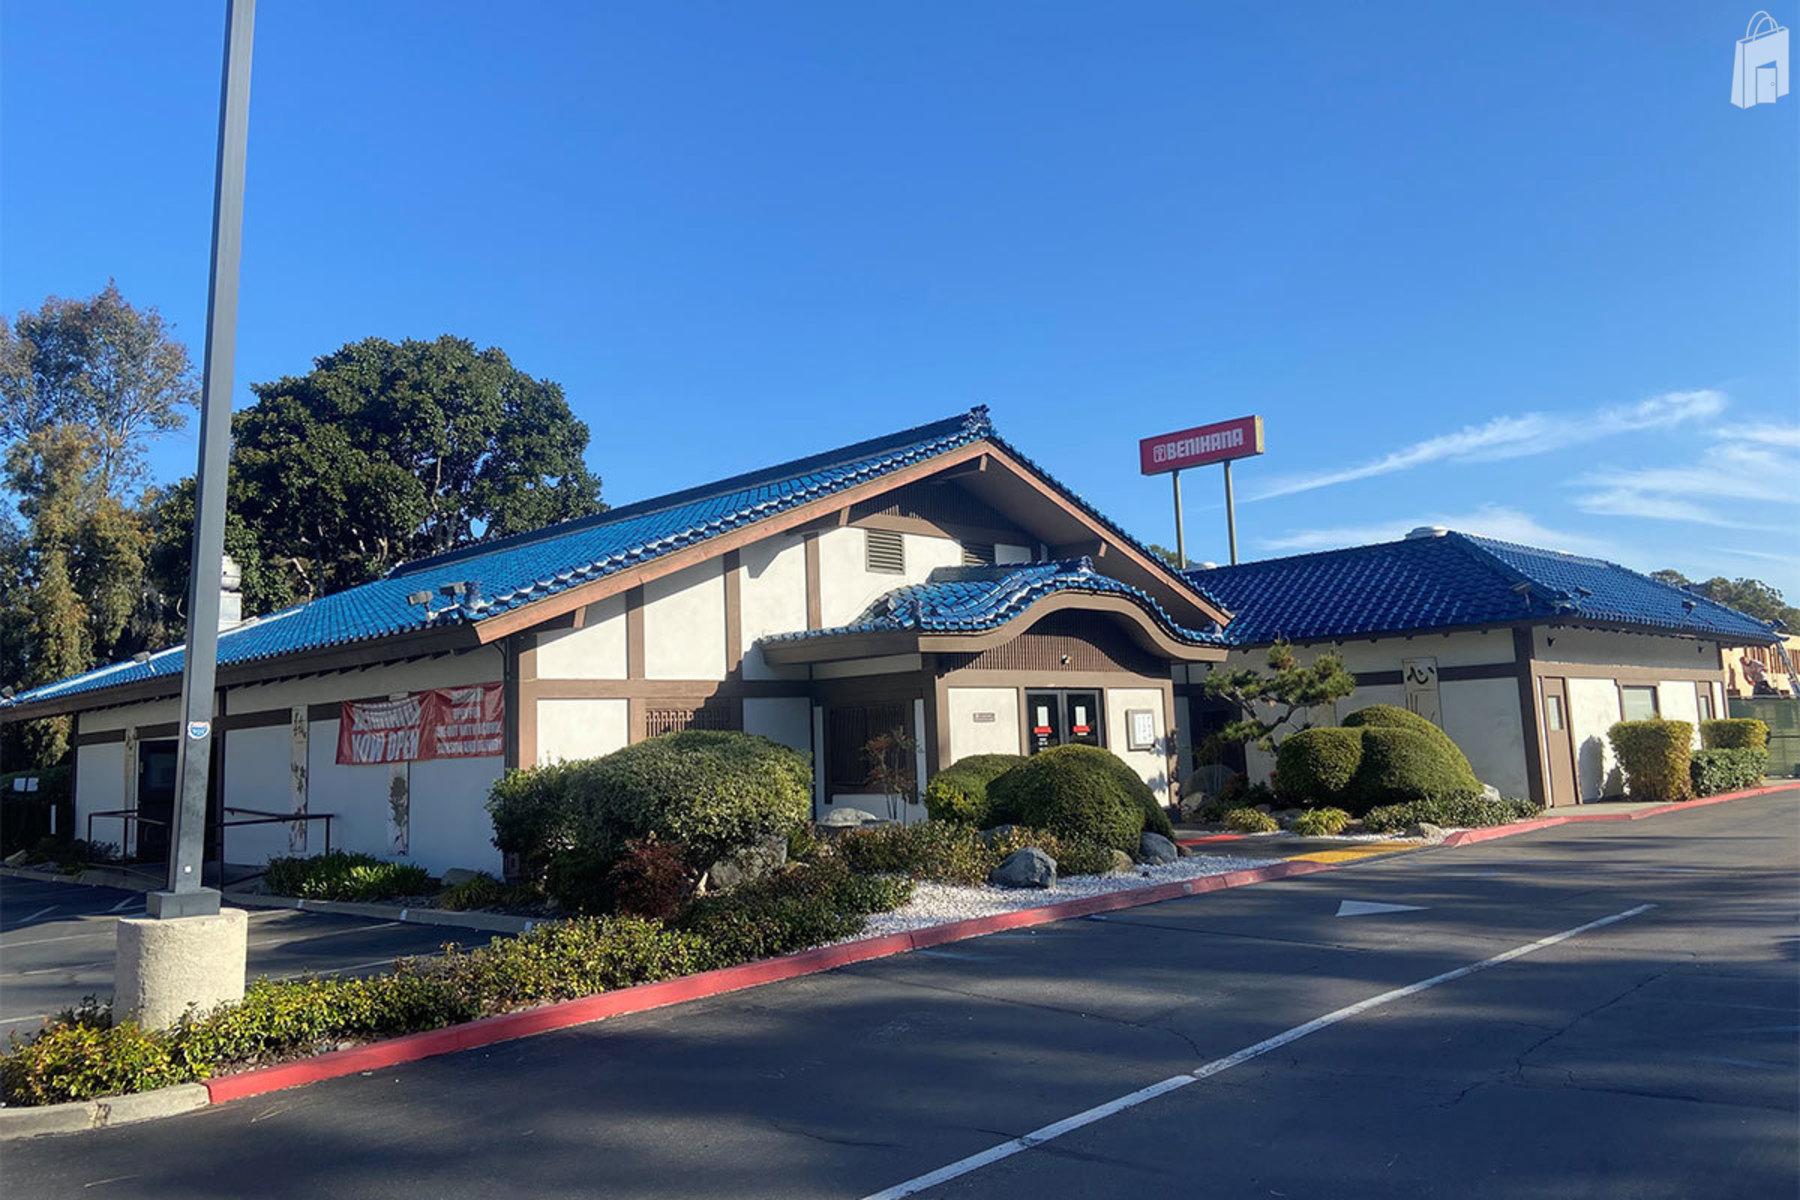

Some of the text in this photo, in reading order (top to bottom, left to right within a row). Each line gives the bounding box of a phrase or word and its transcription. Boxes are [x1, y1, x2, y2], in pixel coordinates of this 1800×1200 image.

[1167, 428, 1244, 460] BENIHANA
[352, 732, 385, 763] NOW
[386, 729, 419, 761] OPEN
